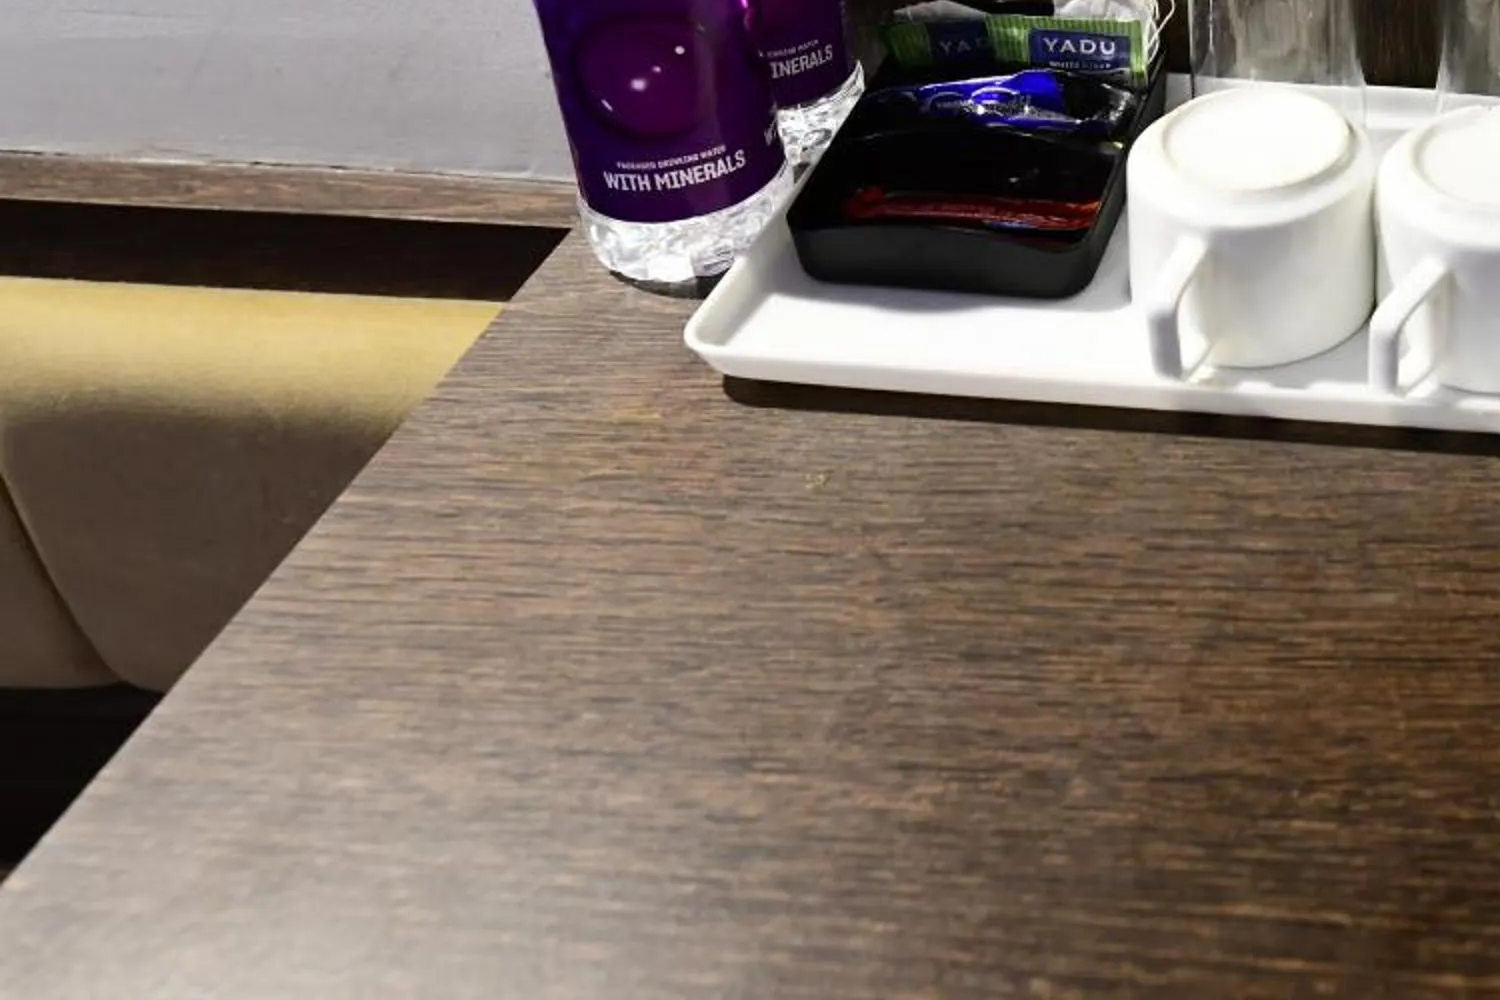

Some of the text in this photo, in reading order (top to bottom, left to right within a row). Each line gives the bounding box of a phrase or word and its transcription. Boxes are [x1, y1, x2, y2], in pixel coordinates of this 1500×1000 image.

[770, 44, 833, 79] INERALS
[1043, 37, 1116, 55] YADU
[603, 149, 747, 191] WITH MINERALS
